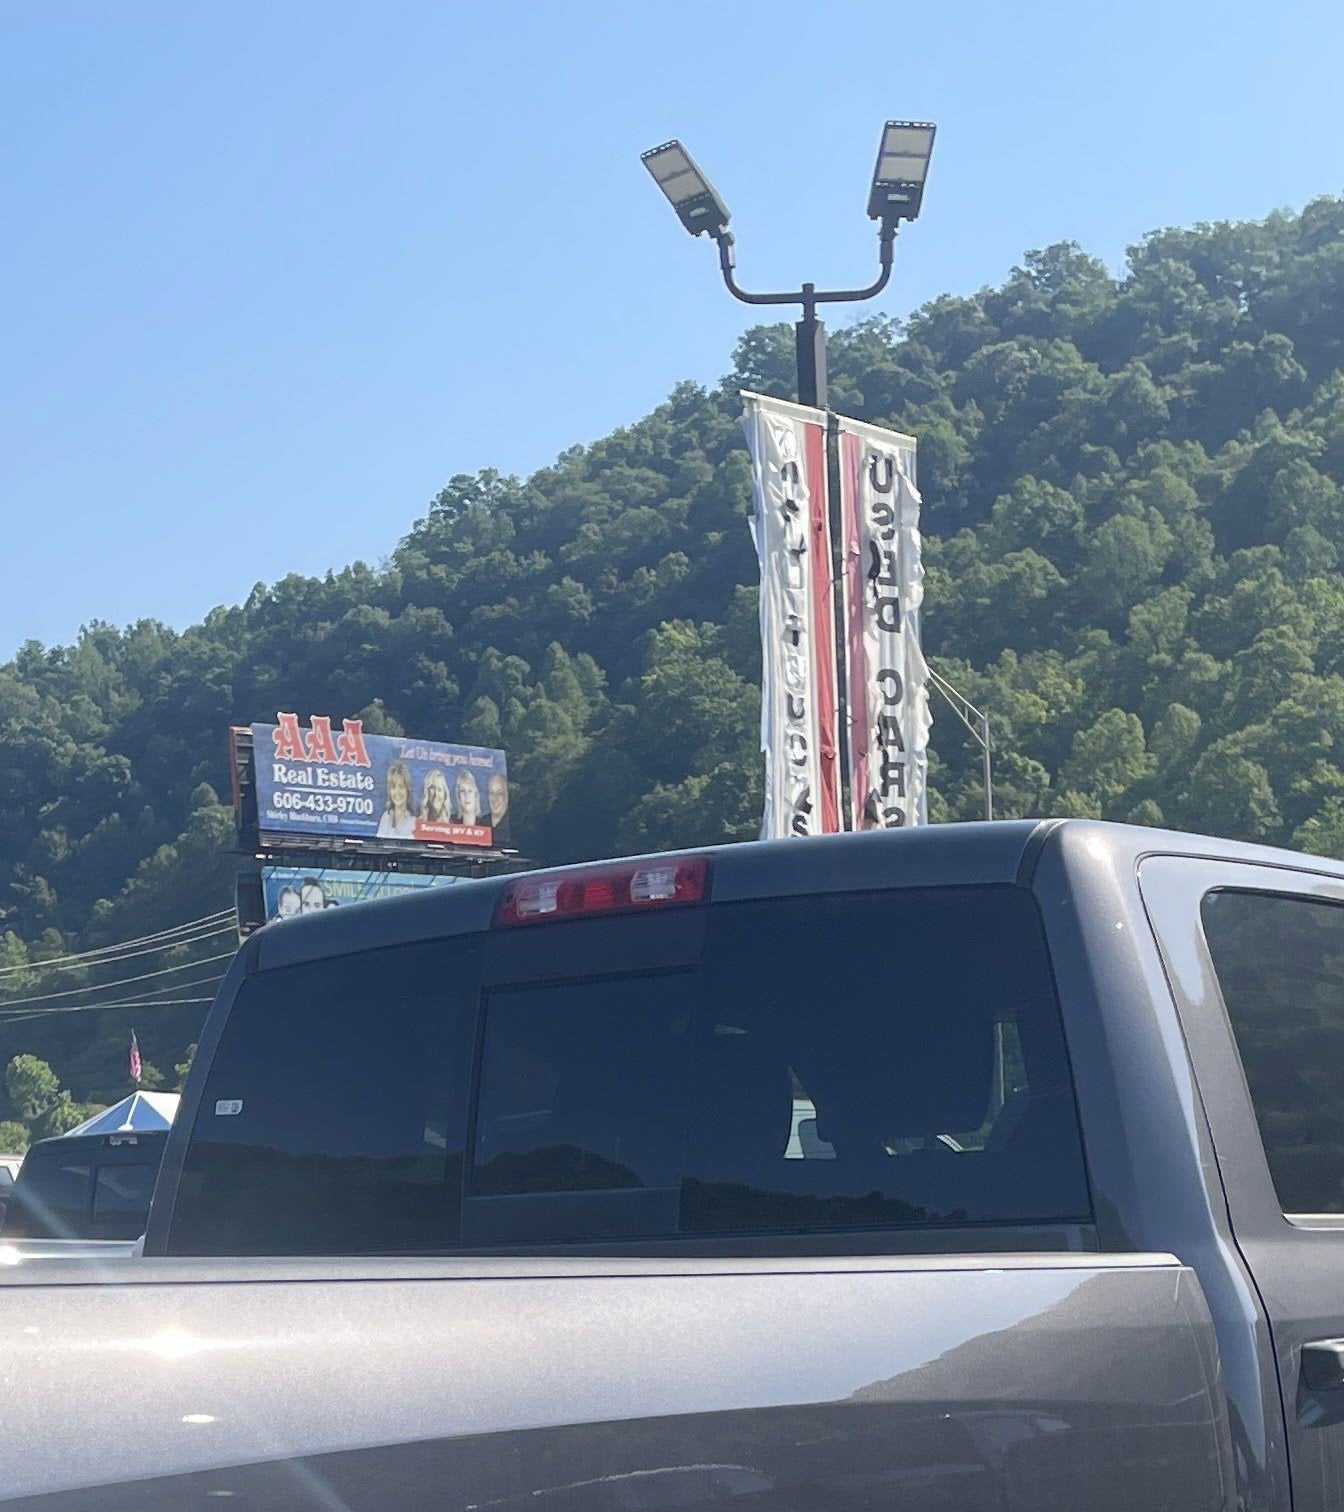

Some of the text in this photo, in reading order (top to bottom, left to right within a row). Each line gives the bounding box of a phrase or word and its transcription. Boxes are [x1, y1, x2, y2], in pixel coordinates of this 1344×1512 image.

[272, 711, 372, 767] AAA
[272, 763, 375, 791] Real Estate
[272, 791, 374, 815] 606-433-9700
